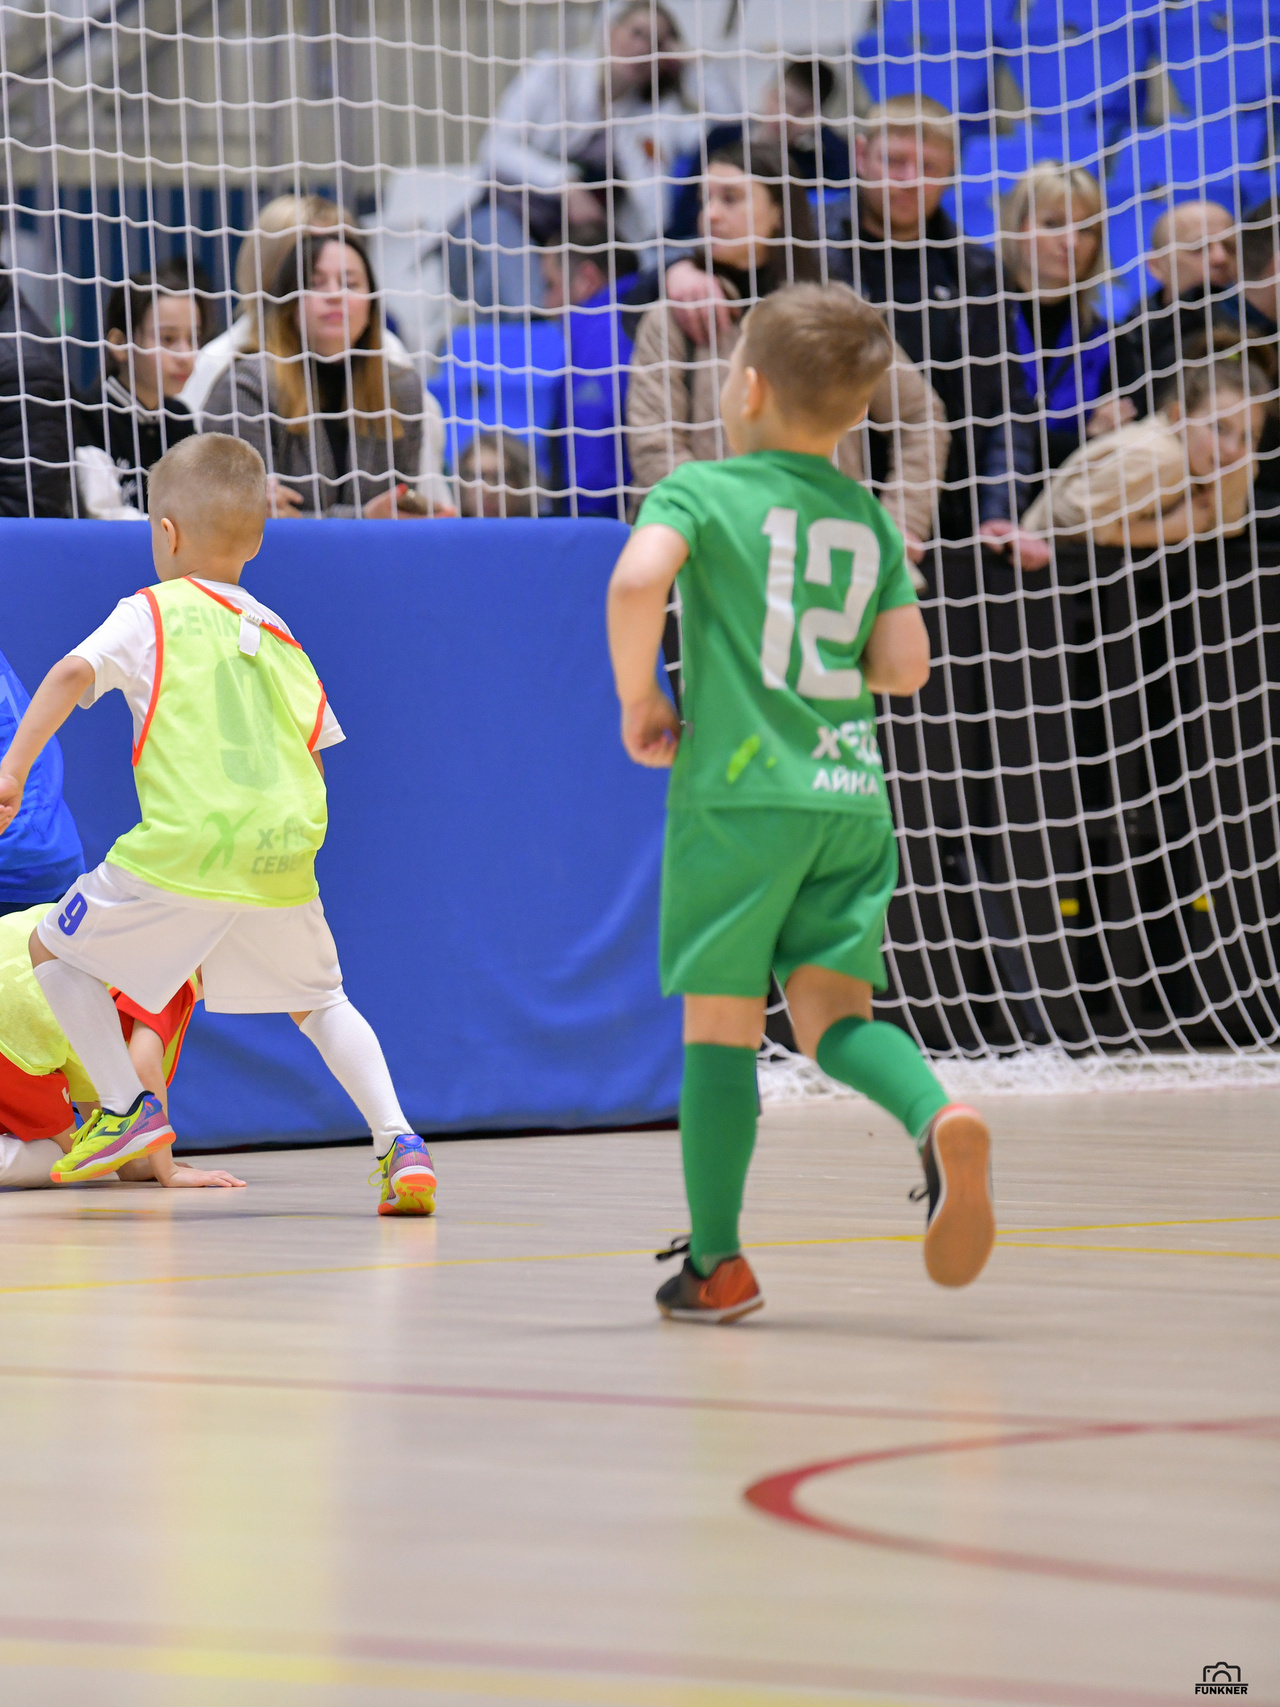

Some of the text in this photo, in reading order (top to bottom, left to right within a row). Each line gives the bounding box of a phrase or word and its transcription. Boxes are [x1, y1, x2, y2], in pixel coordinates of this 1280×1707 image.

[760, 506, 881, 699] 12
[214, 656, 280, 790] 9
[250, 854, 308, 875] СЕВЕ
[58, 892, 88, 936] 9
